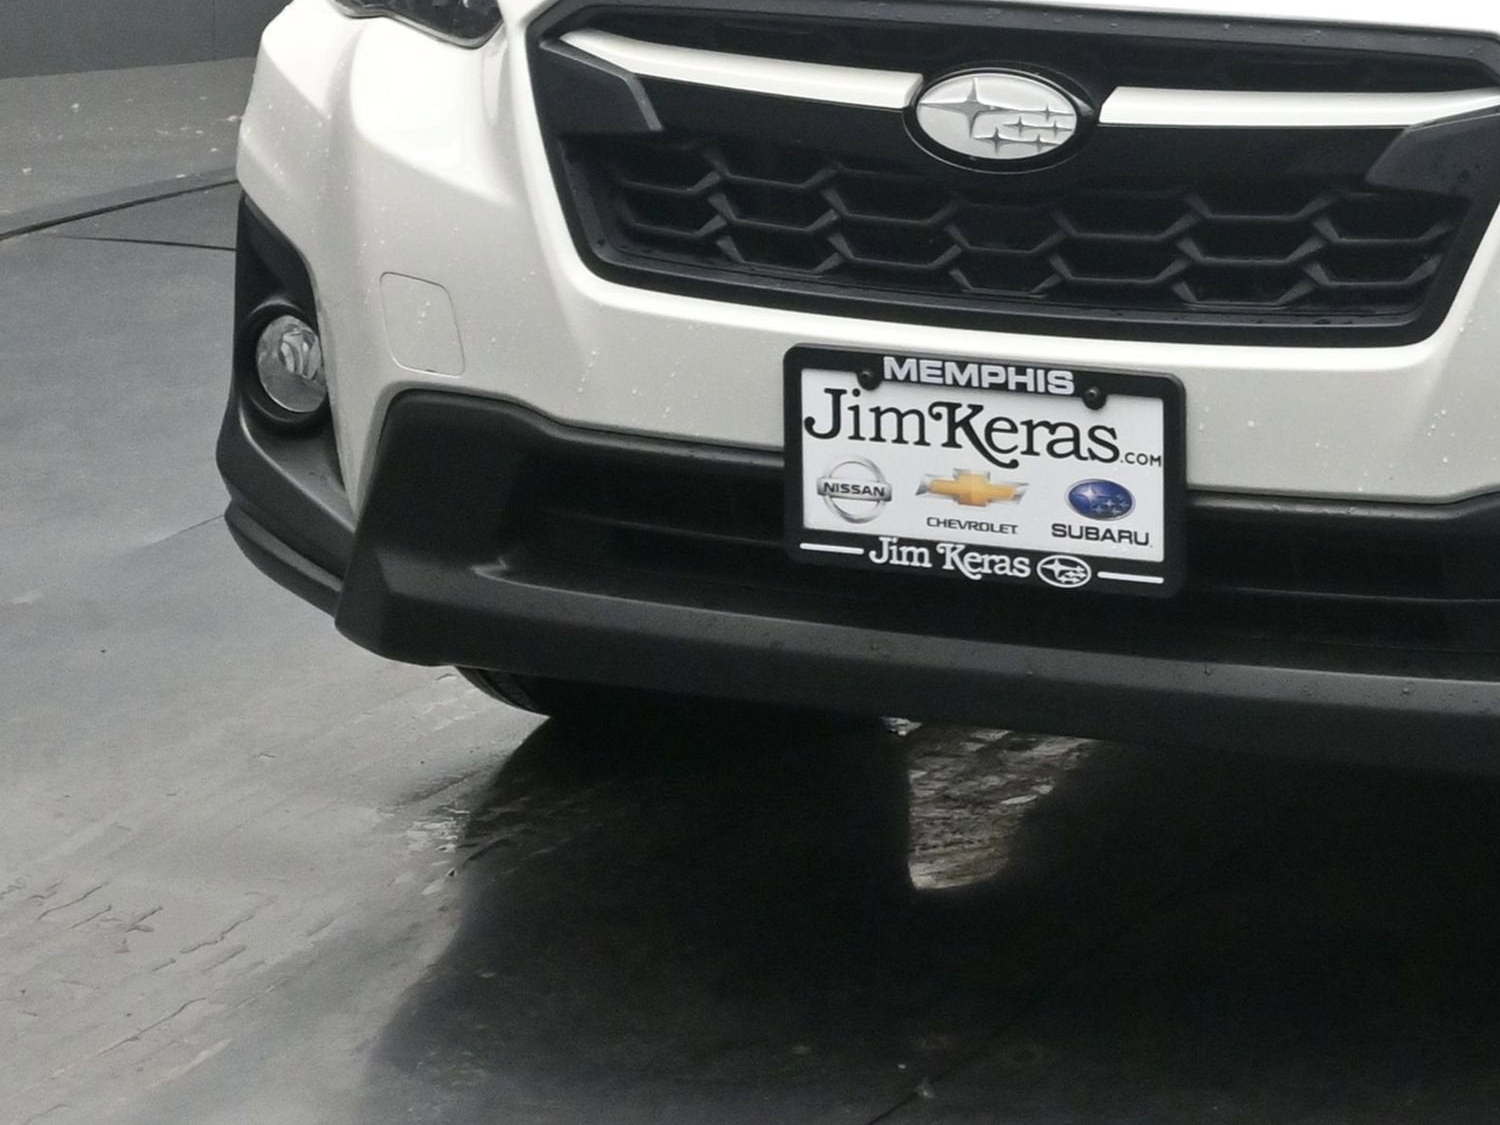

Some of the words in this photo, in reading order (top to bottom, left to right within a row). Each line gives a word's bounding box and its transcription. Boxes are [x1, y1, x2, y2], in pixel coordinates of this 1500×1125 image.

[883, 356, 1075, 396] MEMPHIS
[822, 481, 886, 497] NISSAN
[926, 516, 1018, 535] CHEVROLET
[1051, 523, 1149, 546] SUBARU
[868, 536, 932, 569] Jim
[936, 543, 1031, 580] Keras
